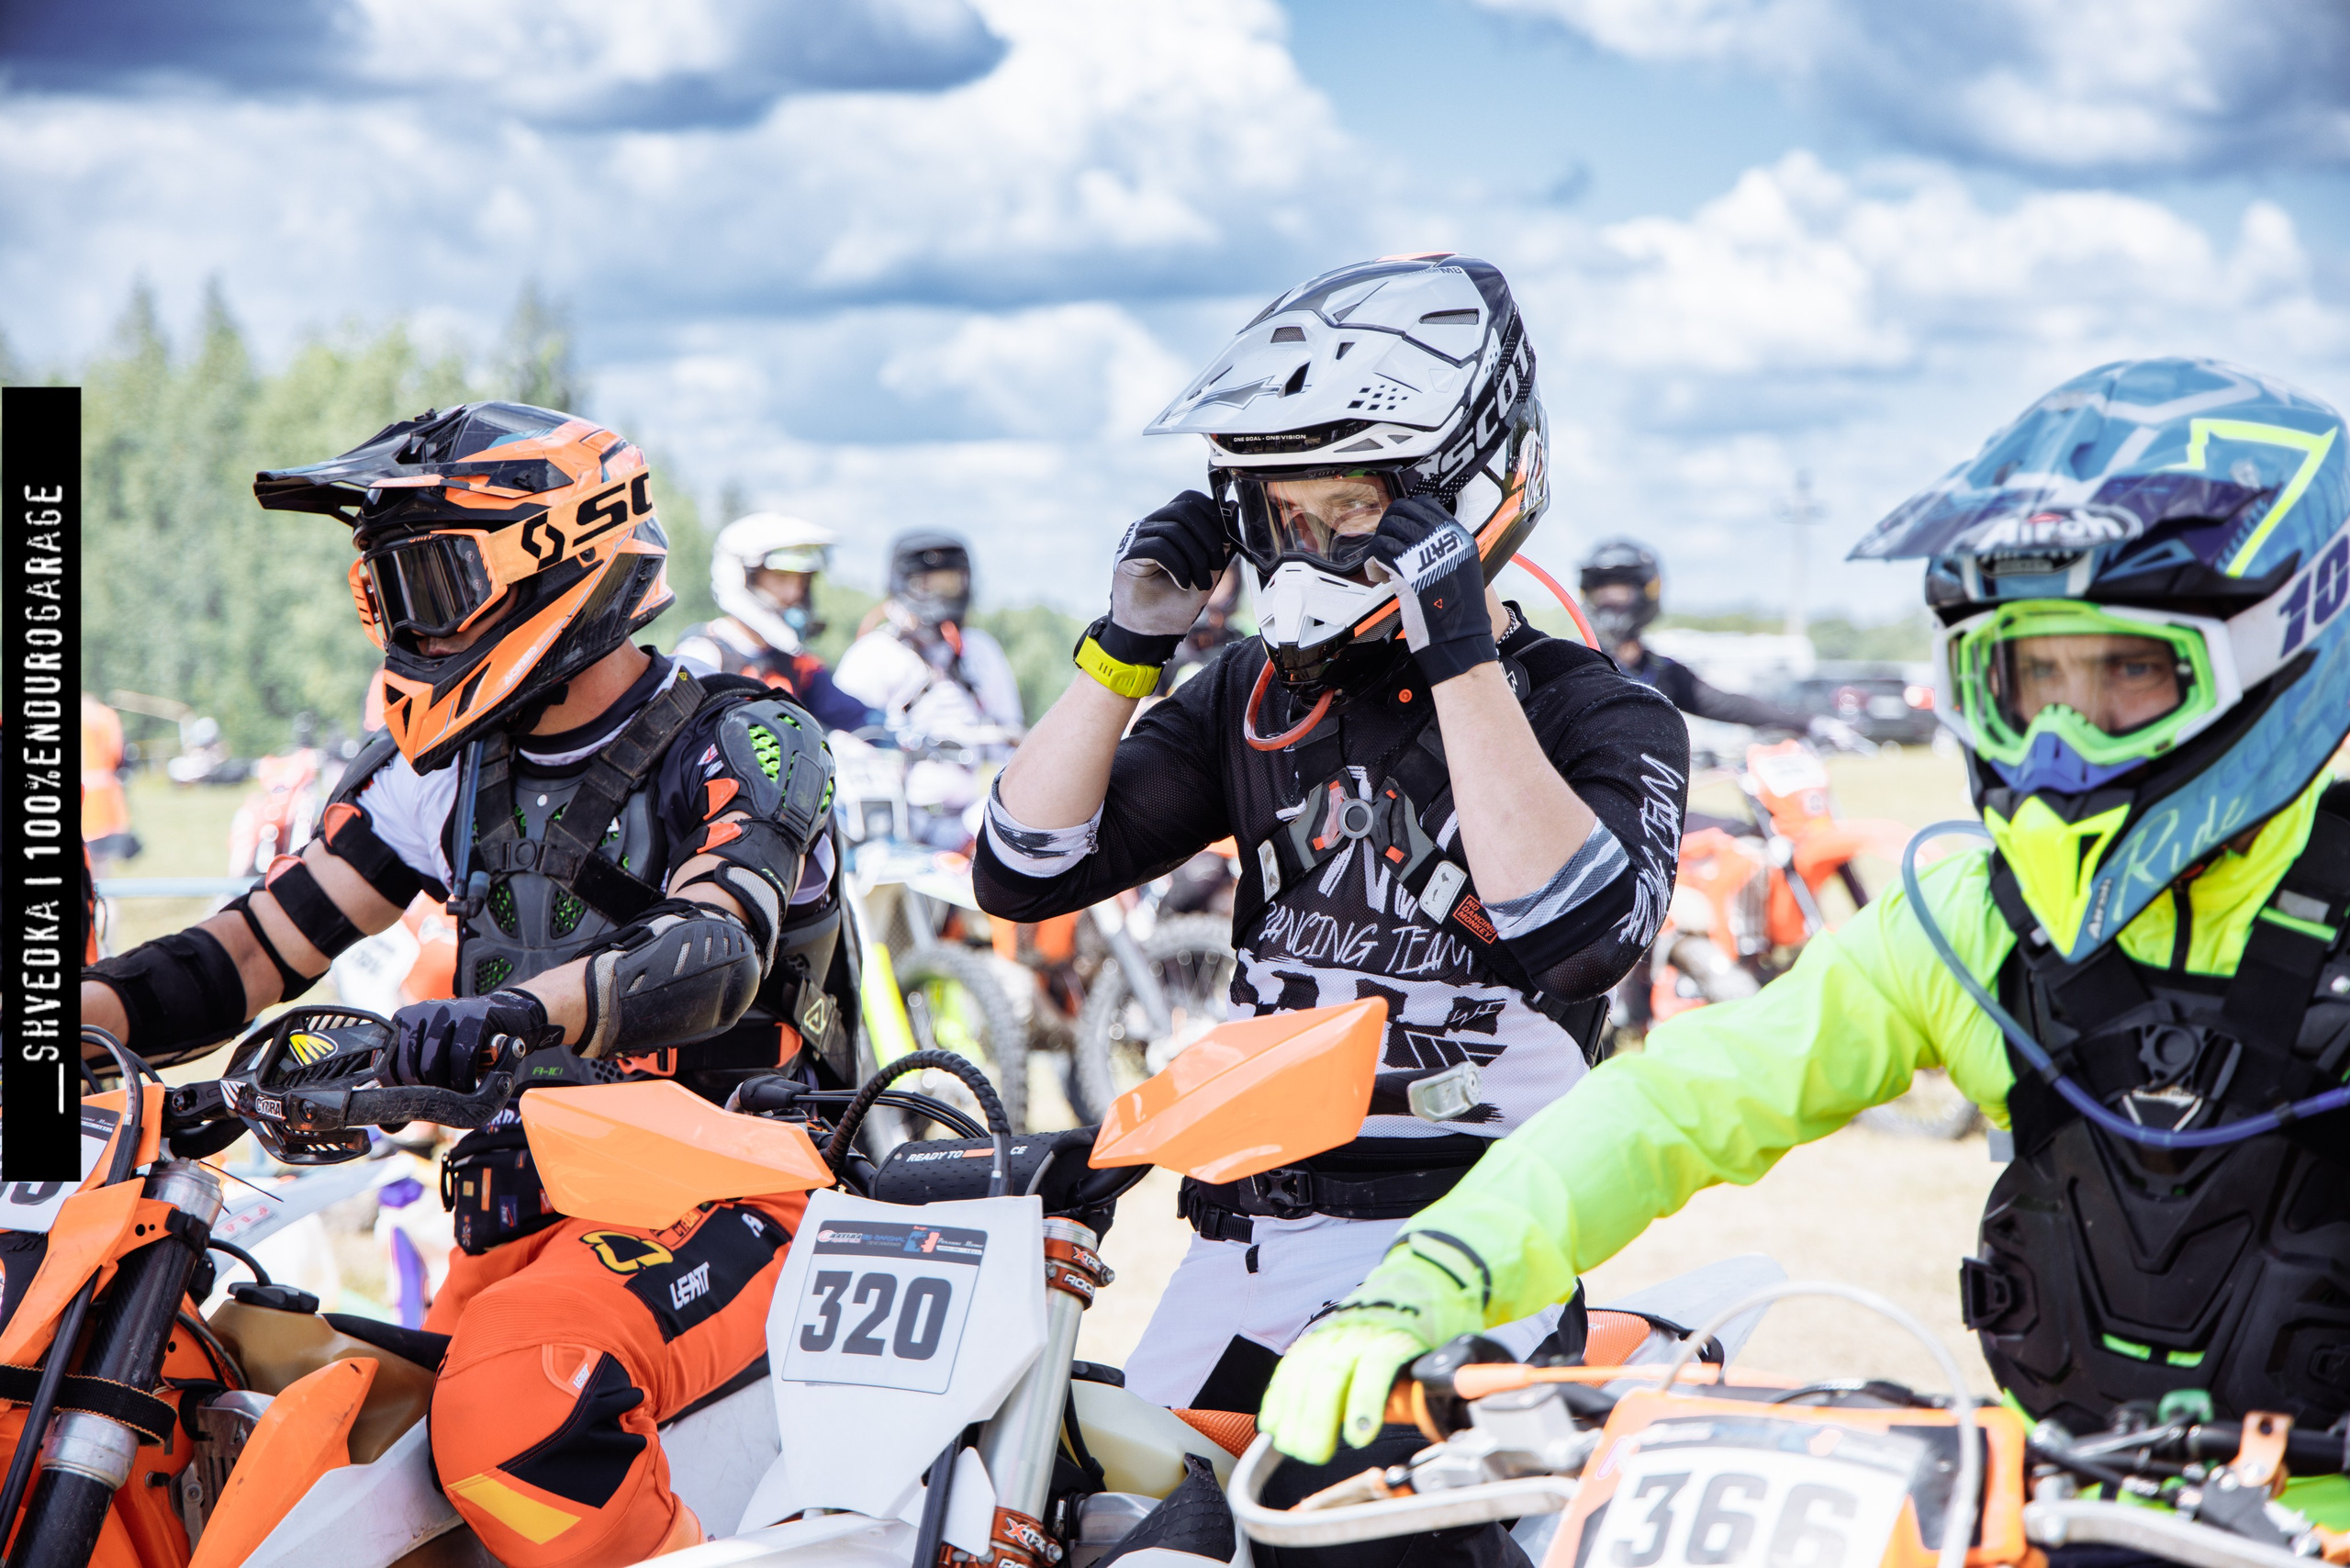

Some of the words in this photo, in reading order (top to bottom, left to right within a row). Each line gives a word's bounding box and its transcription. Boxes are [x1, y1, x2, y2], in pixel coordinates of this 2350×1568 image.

[1439, 331, 1532, 489] SCOT
[1417, 530, 1464, 574] LEATT
[1974, 509, 2125, 554] Airoh
[1457, 911, 1493, 938] MONKEY
[1461, 905, 1496, 935] DANCING
[1466, 900, 1481, 912] NO
[906, 1151, 947, 1162] READY
[947, 1149, 965, 1159] TO
[669, 1260, 711, 1311] LEATT
[800, 1271, 952, 1361] 320
[1610, 1471, 1859, 1568] 366
